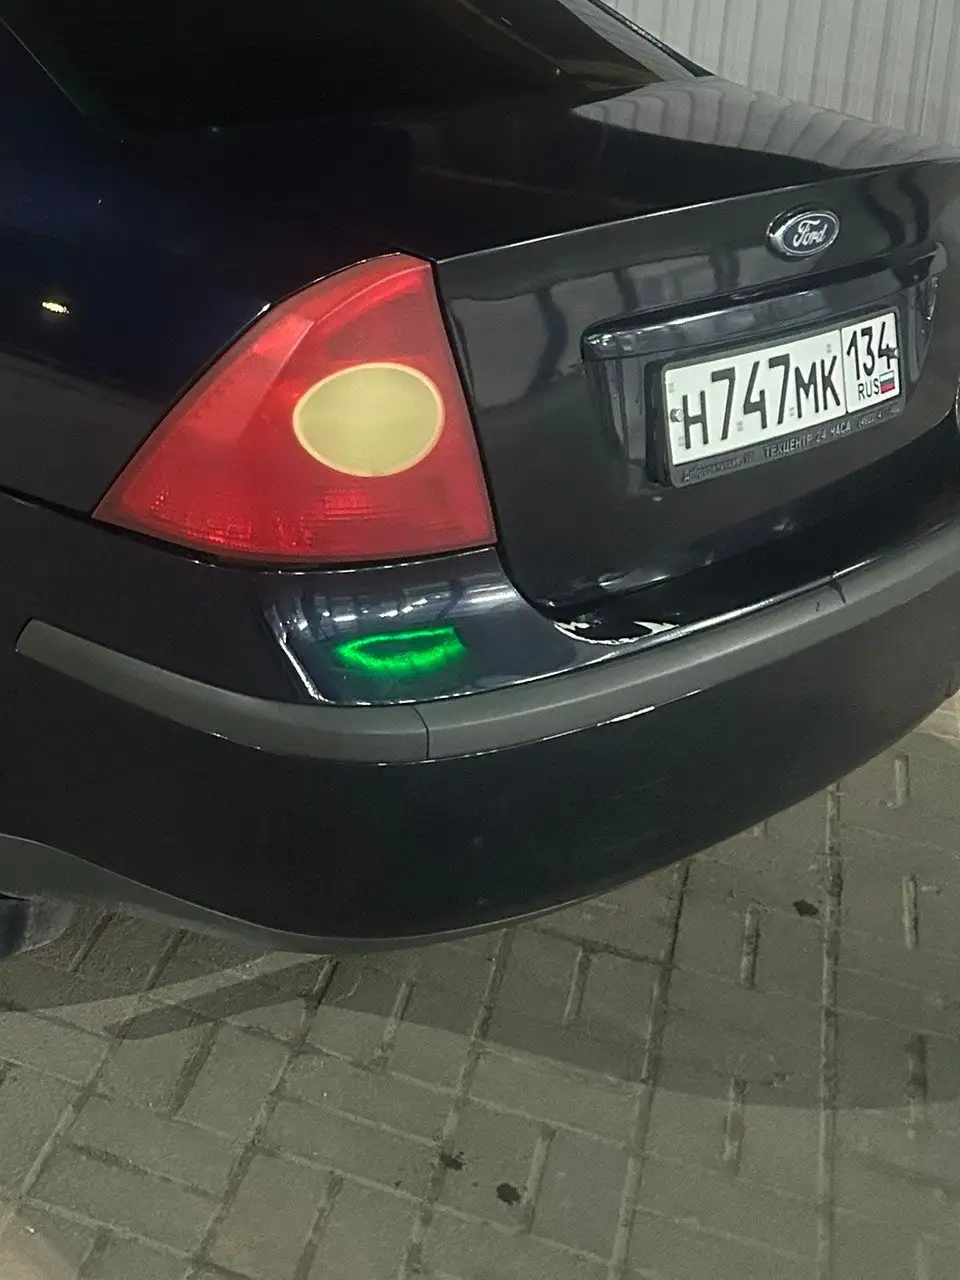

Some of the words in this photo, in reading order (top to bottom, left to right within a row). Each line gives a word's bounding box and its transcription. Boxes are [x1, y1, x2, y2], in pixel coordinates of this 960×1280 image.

[792, 219, 828, 248] Ford
[681, 353, 841, 450] Н747МК
[846, 321, 892, 381] 134
[857, 377, 880, 402] RUS
[763, 433, 813, 459] ТЕХЦЕНТР
